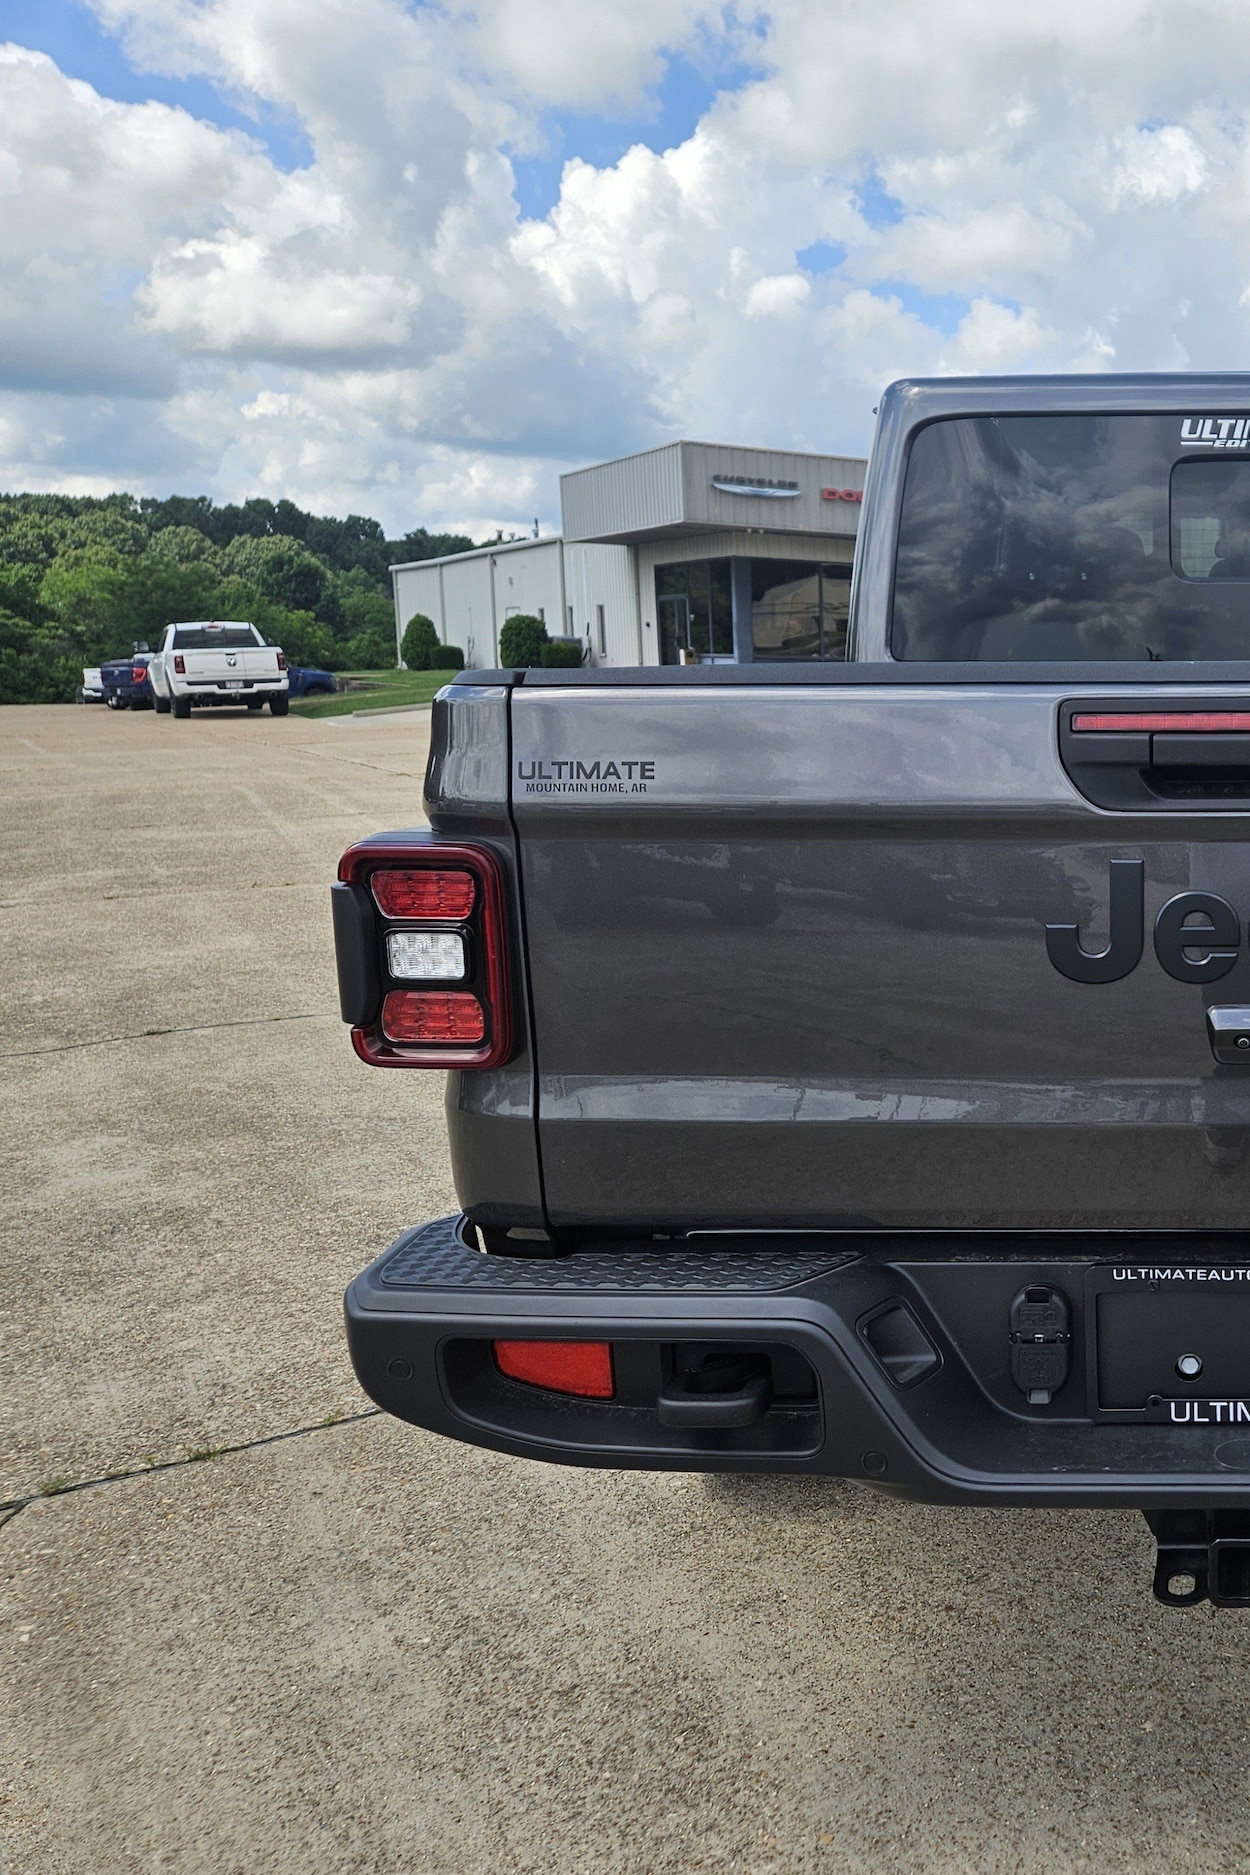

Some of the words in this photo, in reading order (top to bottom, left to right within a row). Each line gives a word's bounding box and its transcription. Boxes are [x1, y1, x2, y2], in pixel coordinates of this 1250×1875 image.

[518, 761, 655, 780] ULTIMATE
[526, 783, 588, 793] MOUNTAIN
[591, 783, 628, 794] HOME,
[631, 783, 647, 793] AR
